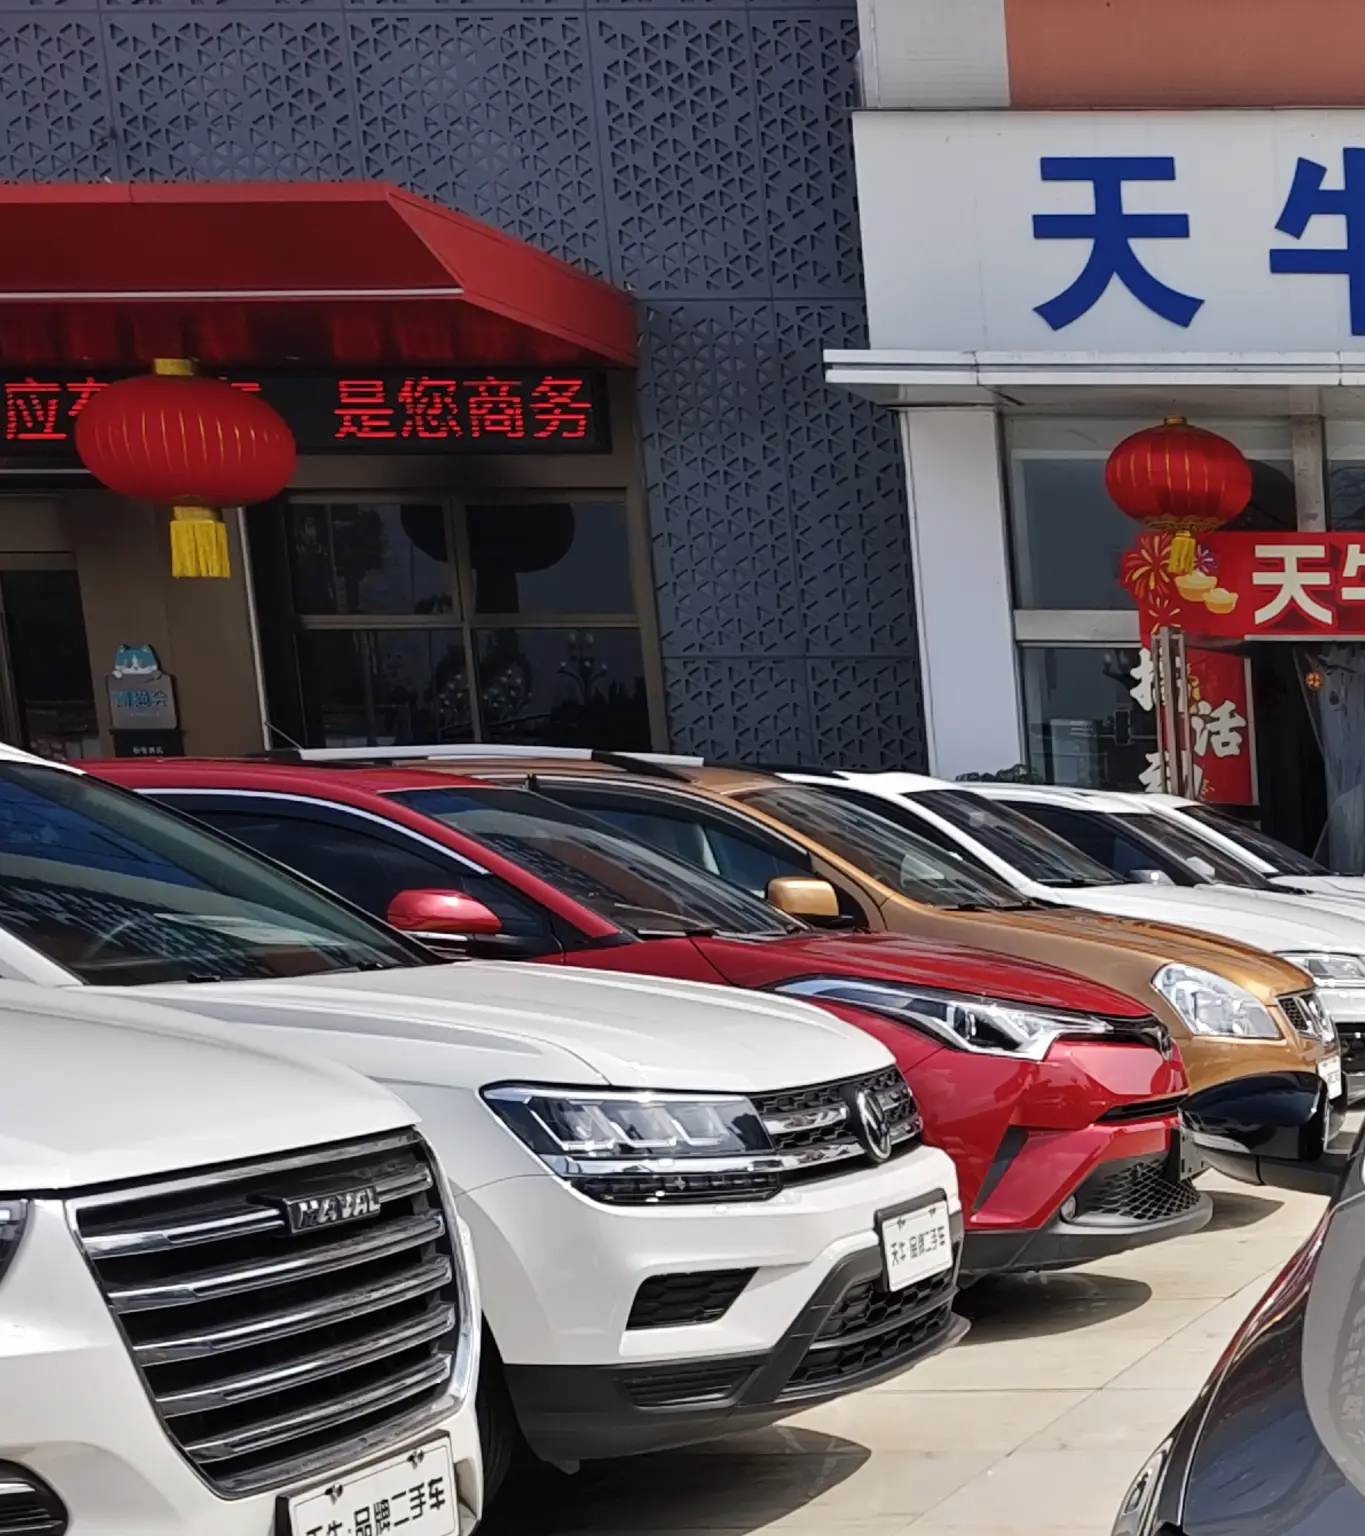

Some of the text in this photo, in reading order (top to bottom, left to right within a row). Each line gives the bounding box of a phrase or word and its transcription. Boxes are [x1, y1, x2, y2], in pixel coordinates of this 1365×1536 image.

[333, 376, 592, 441] 是您商务
[298, 1187, 382, 1229] HAVAL
